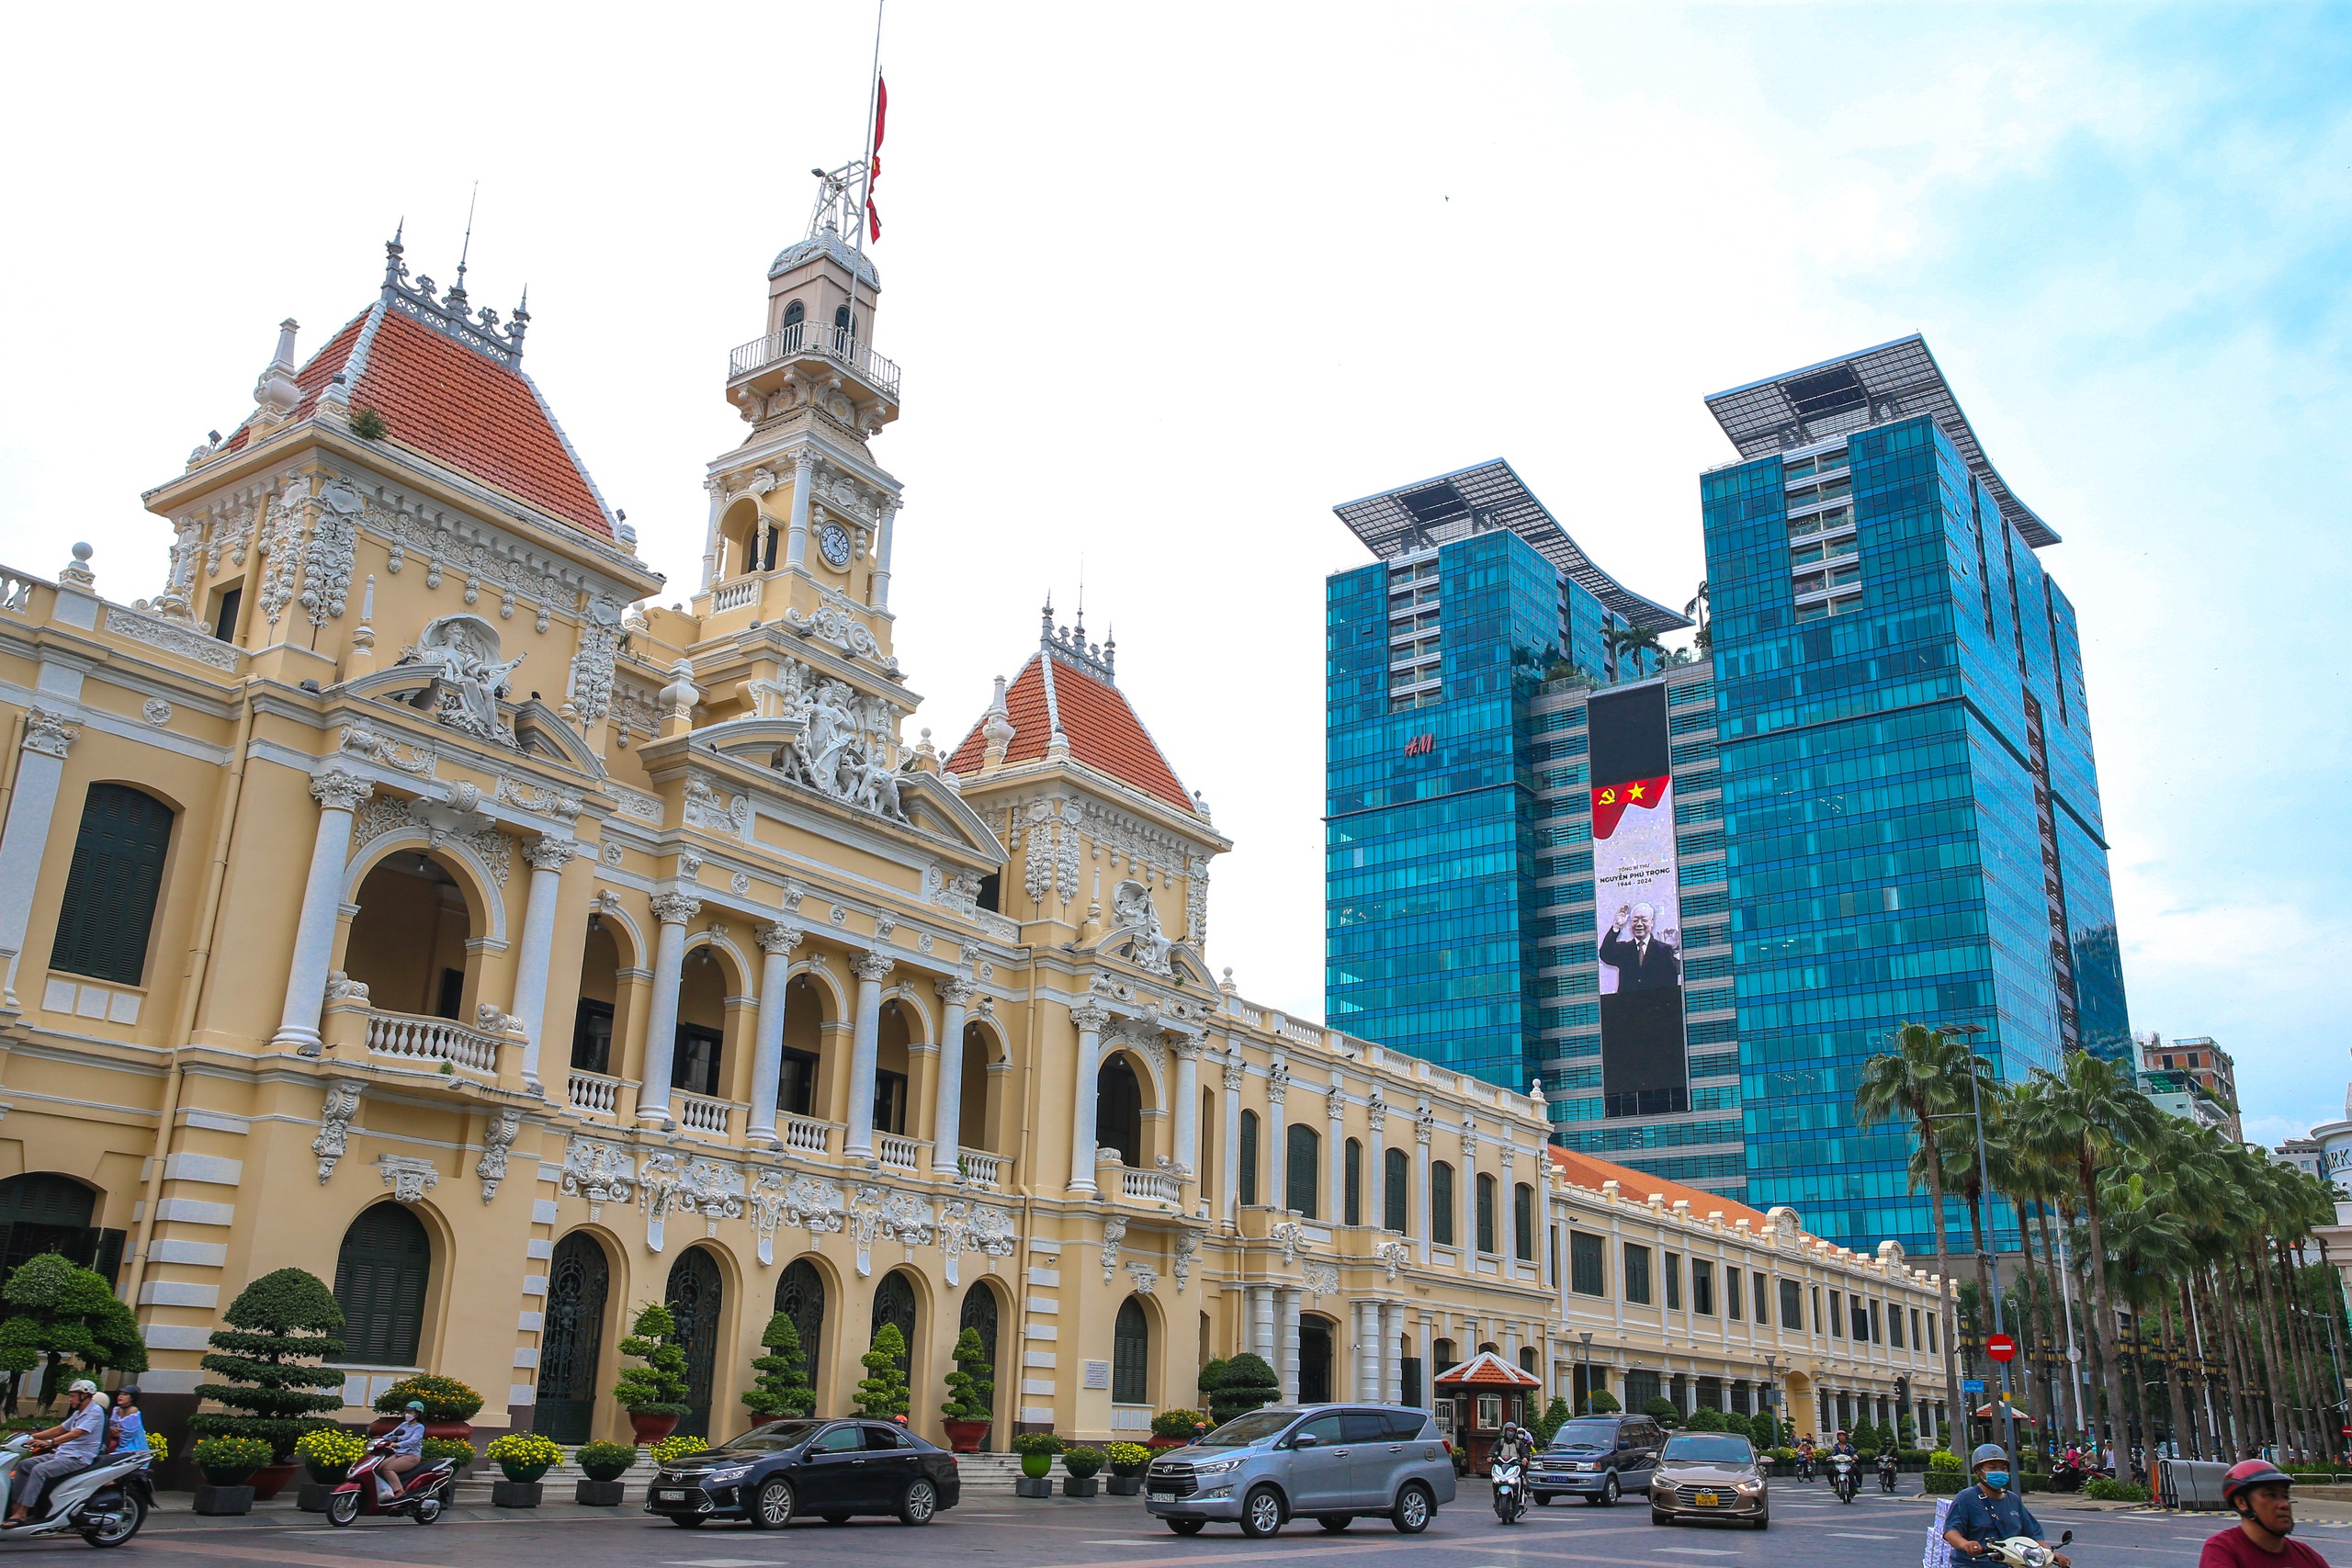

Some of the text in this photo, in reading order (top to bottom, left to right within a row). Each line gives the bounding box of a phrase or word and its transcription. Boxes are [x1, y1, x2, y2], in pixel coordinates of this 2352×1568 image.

[1404, 732, 1433, 758] H&M
[1600, 867, 1670, 884] NGUYỄN PHÚ TRỌNG
[1617, 880, 1632, 888] 1944
[1636, 877, 1652, 886] 2024
